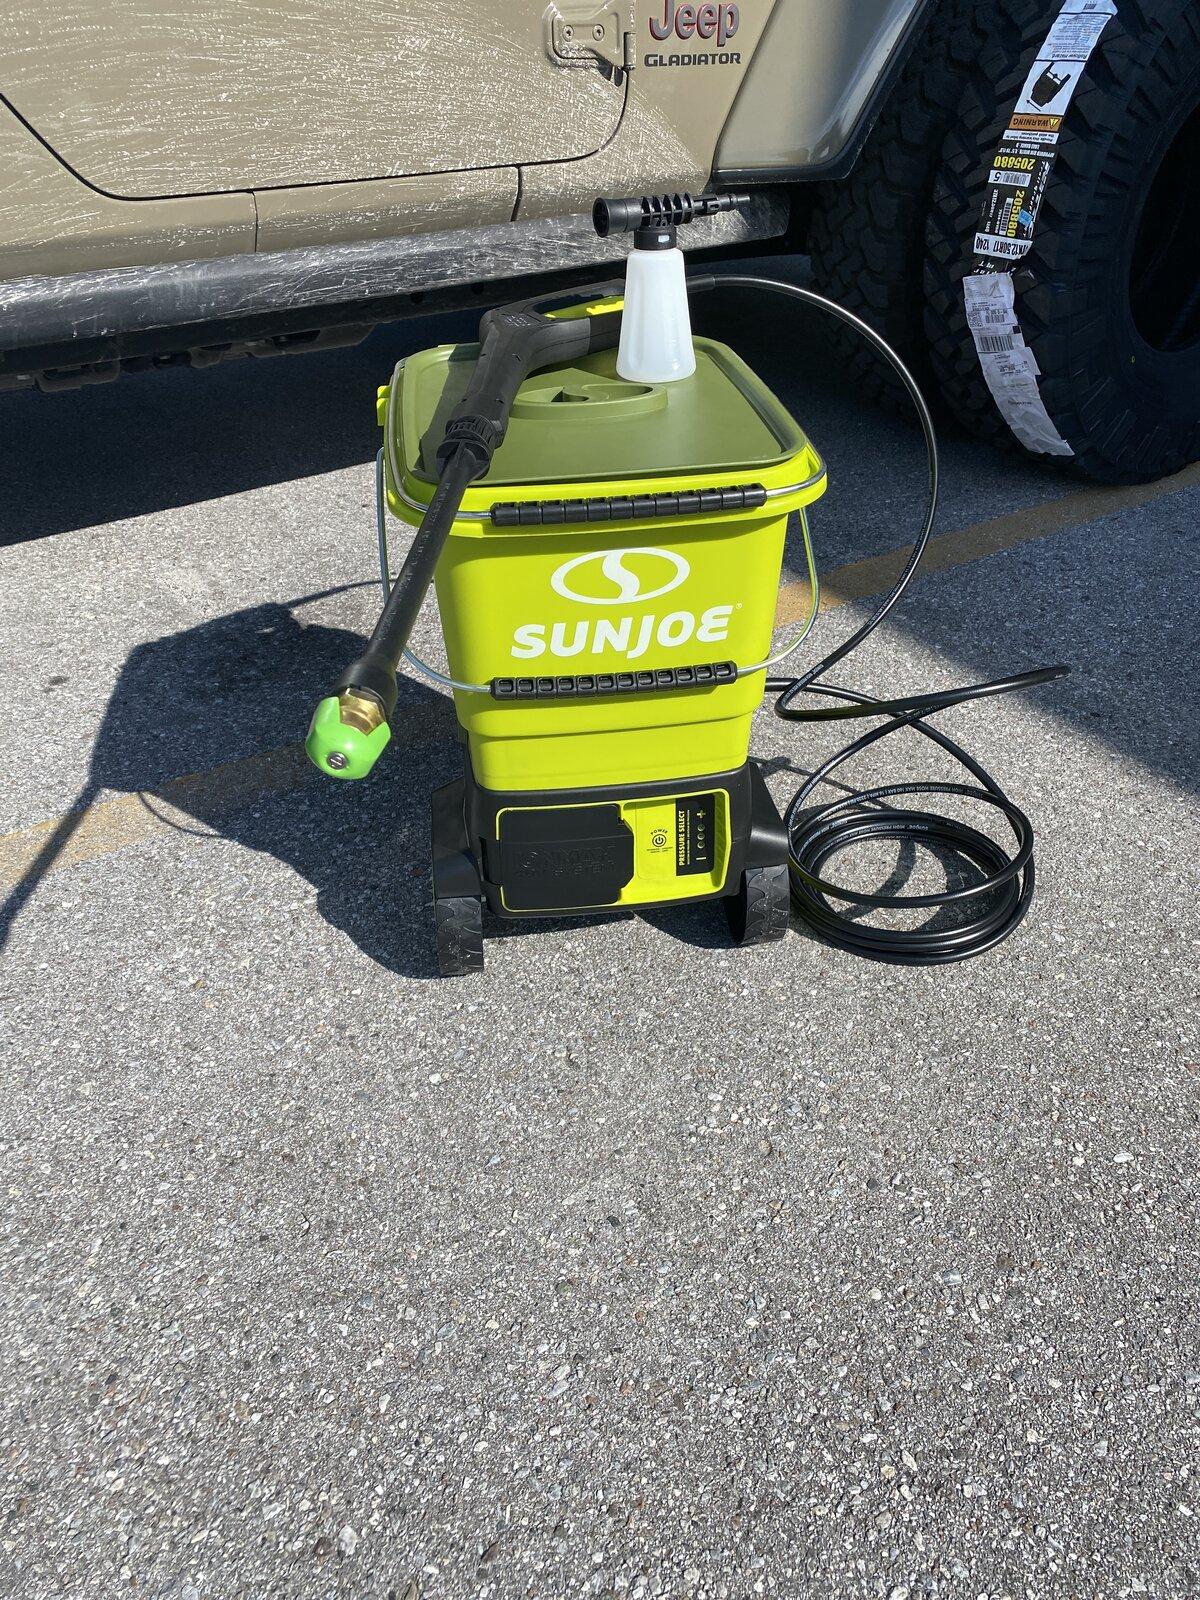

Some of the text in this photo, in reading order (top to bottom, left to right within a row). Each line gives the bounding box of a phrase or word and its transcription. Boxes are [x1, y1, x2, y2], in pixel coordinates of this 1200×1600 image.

[649, 0, 740, 47] Jeep
[644, 53, 741, 67] GLADIATOR
[1013, 118, 1049, 126] WARNING
[993, 155, 1036, 171] 205880
[993, 171, 1002, 182] 5
[1006, 189, 1026, 238] 205880
[510, 604, 734, 659] SUNJOE
[678, 833, 686, 866] PRESSURE
